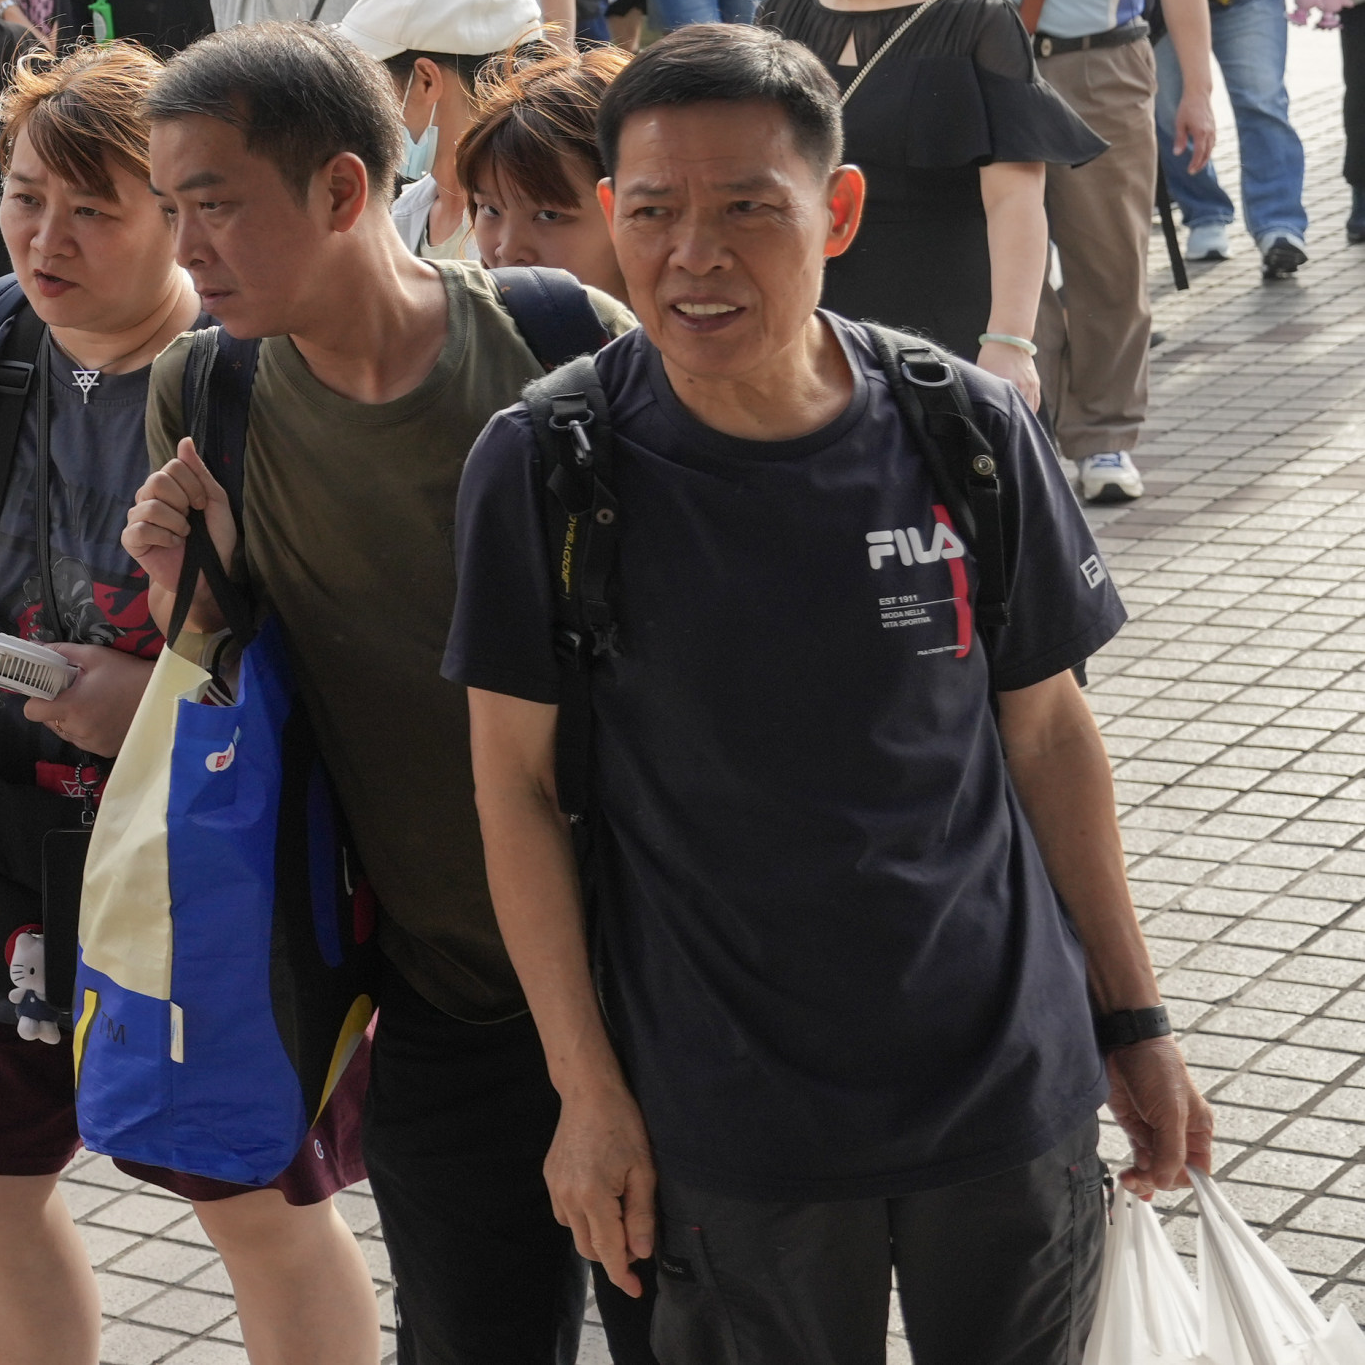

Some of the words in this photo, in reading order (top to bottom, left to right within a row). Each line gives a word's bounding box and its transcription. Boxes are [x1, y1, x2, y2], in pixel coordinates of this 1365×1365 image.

[865, 522, 966, 570] FILA
[878, 596, 897, 606] EST
[898, 594, 918, 604] 1911
